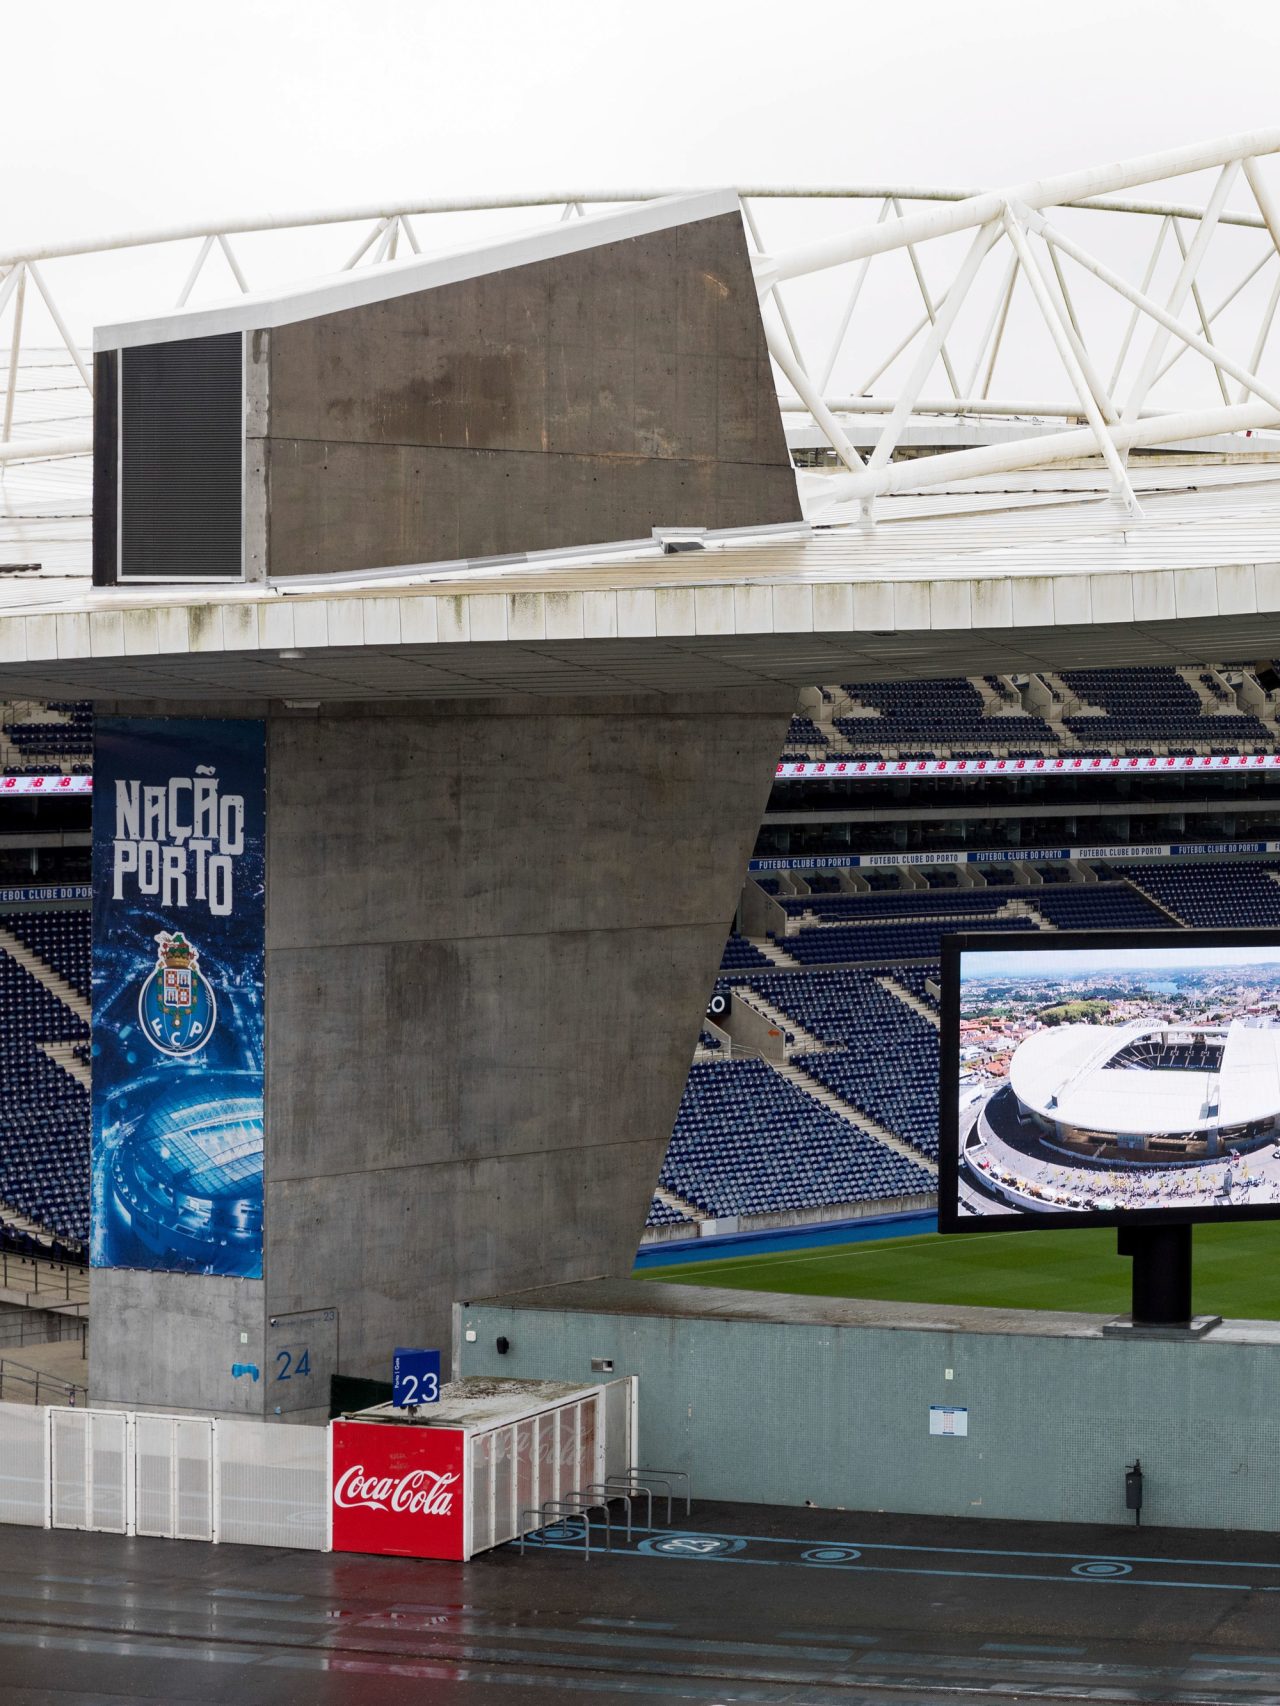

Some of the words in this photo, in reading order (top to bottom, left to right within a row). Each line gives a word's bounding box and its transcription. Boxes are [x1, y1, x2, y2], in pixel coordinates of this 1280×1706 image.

[115, 764, 244, 856] NAÇÃO
[1142, 847, 1161, 855] PORTO
[1179, 846, 1206, 854] FUTEBOL
[1207, 845, 1226, 853] CLUBE
[1239, 844, 1258, 852] PORTO
[870, 856, 900, 864] FUTEBOL
[926, 855, 934, 863] DO
[936, 854, 958, 862] PORTO
[977, 853, 1005, 861] FUTEBOL
[1008, 852, 1029, 860] CLUBE
[759, 861, 790, 869] FUTEBOL
[792, 860, 814, 868] CLUBE
[816, 859, 825, 867] DO
[828, 858, 850, 866] PORTO
[112, 839, 232, 915] PORTO
[28, 889, 58, 899] CLUBE
[60, 888, 72, 898] DO
[75, 887, 93, 898] POR
[707, 996, 725, 1013] O
[323, 1311, 335, 1322] 23
[276, 1348, 311, 1381] 24
[402, 1372, 438, 1405] 23
[334, 1465, 460, 1515] Coca-Cola
